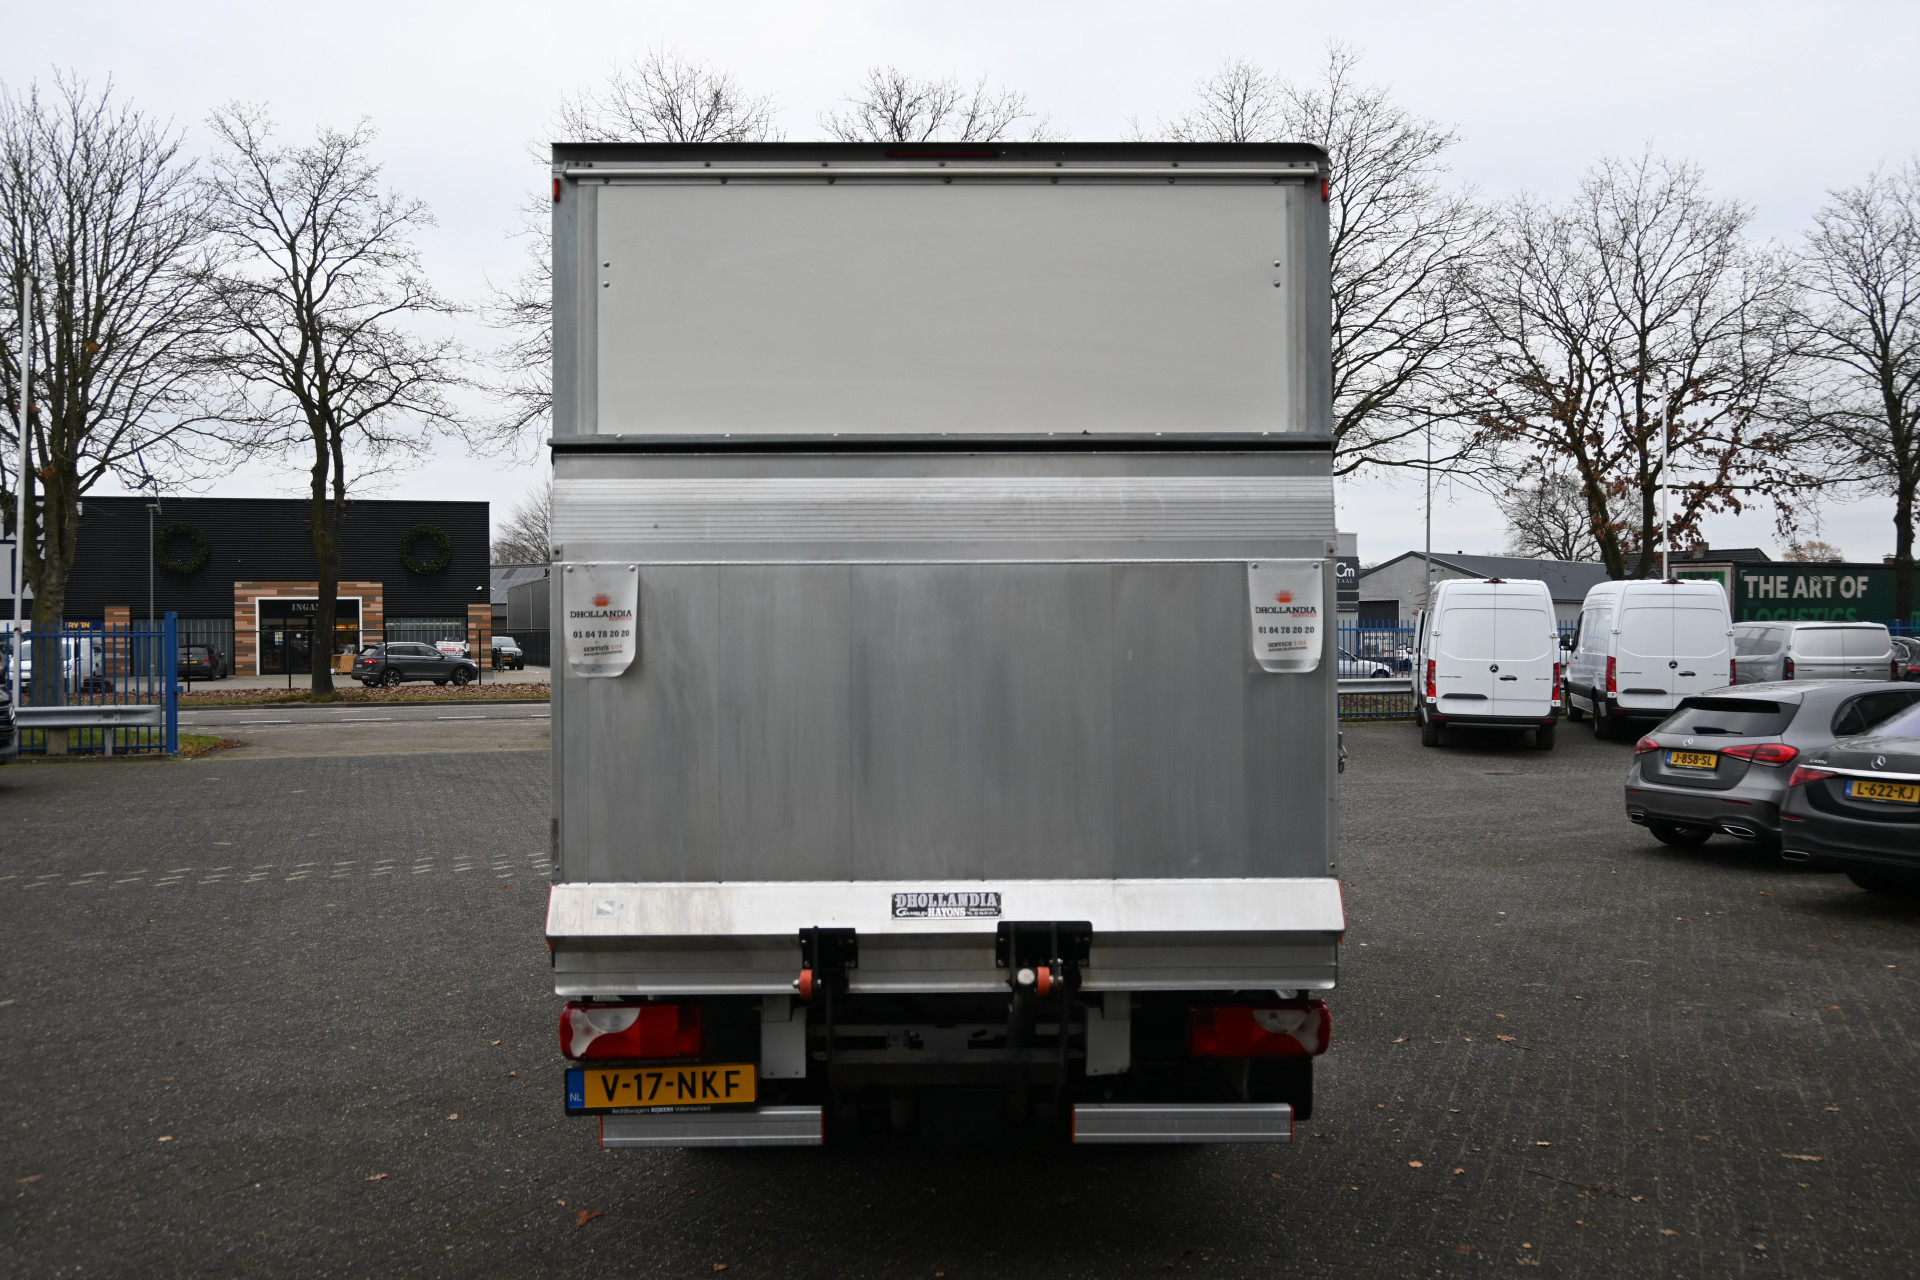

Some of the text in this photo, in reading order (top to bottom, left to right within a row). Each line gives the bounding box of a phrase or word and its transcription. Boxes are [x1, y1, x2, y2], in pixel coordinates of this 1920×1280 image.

[1744, 575, 1869, 598] THE ART OF
[570, 610, 632, 618] DHOLLANDIA
[1255, 606, 1317, 614] DHOLLANDIA
[573, 631, 582, 639] 01
[598, 630, 608, 638] 78
[609, 630, 619, 638] 20
[621, 629, 630, 637] 20
[1304, 626, 1315, 634] 20
[1674, 753, 1713, 766] J-858-SL
[1857, 782, 1915, 799] L-622-KJ
[895, 893, 998, 907] DHOLLANDIA
[927, 907, 966, 917] HAYONS
[601, 1070, 741, 1102] V-17-NKF
[569, 1093, 582, 1102] NL
